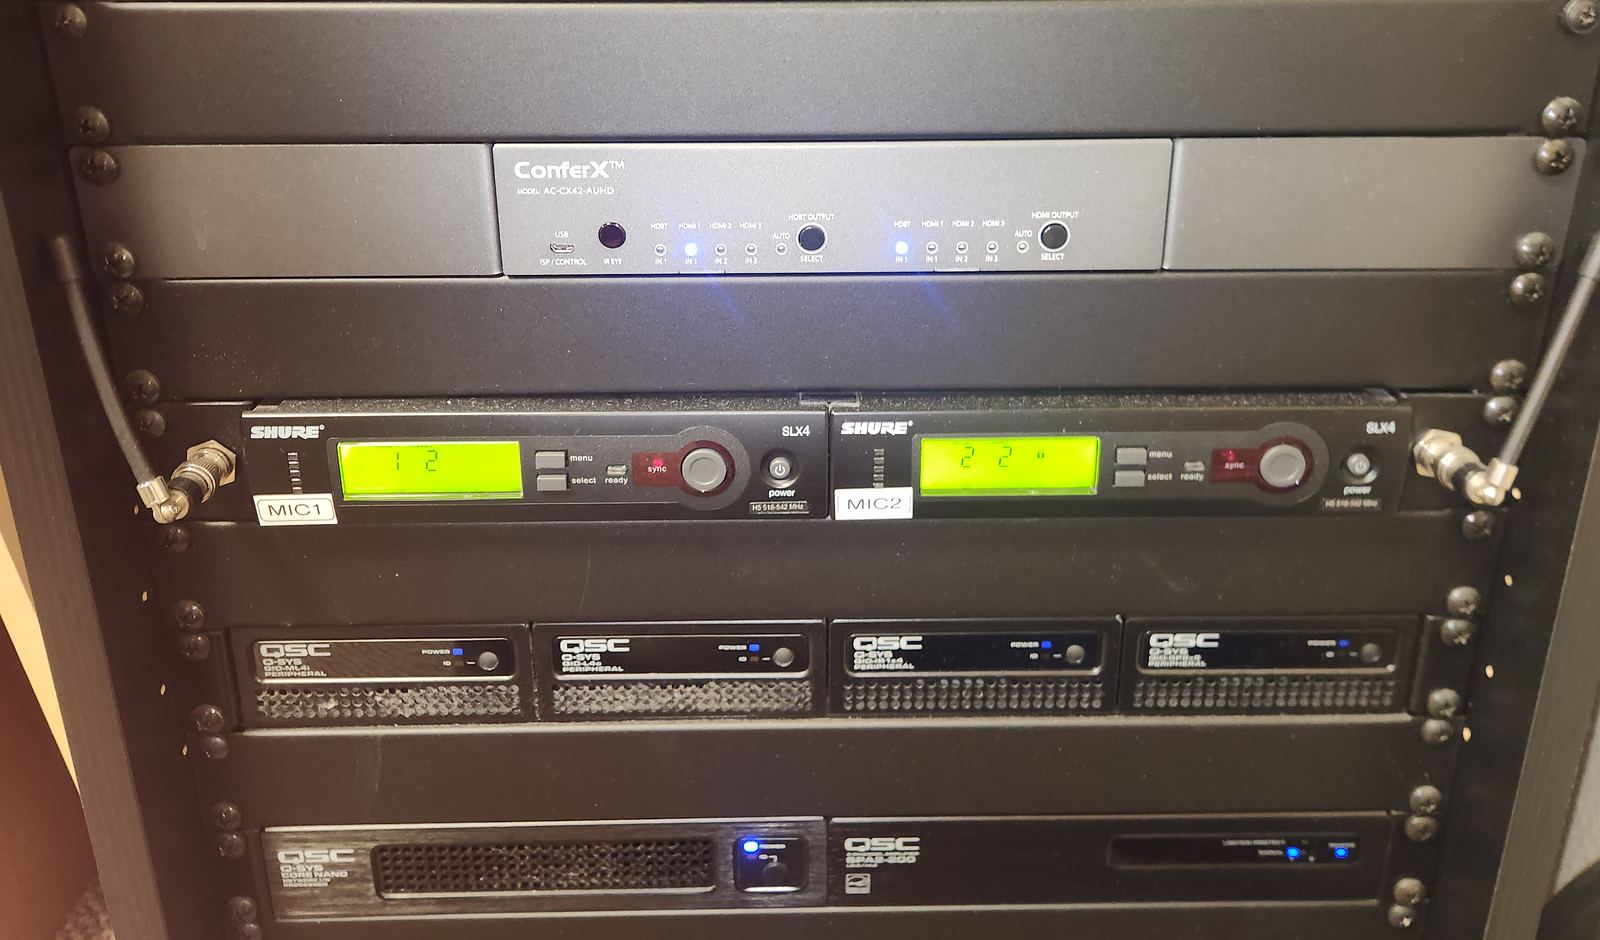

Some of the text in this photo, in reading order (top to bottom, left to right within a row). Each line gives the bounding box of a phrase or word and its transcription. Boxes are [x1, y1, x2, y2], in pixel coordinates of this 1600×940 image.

[543, 186, 615, 195] AC-CX42-AUHD
[808, 212, 835, 222] OUTPUT
[1031, 210, 1079, 219] HDMI OUTPUT
[554, 231, 569, 239] USB
[772, 232, 791, 240] AUTO
[1014, 230, 1033, 238] AUTO
[611, 257, 623, 265] EYE
[655, 257, 663, 265] IN
[685, 257, 693, 265] IN
[714, 257, 722, 265] IN
[744, 257, 752, 265] IN
[799, 254, 824, 263] SELECT
[925, 255, 933, 263] IN
[955, 254, 963, 263] IN
[985, 255, 993, 263] IN
[1040, 253, 1064, 261] SELECT
[555, 258, 588, 266] CONTROL
[781, 425, 811, 437] SLX4
[1365, 421, 1397, 435] SLX4
[570, 454, 593, 462] menu
[960, 445, 1013, 469] 2 2
[1149, 450, 1173, 459] menu
[425, 449, 438, 472] 2
[647, 465, 667, 473] sync
[1225, 461, 1244, 470] sync
[571, 476, 597, 485] select
[604, 476, 629, 486] ready
[1147, 472, 1173, 481] select
[1180, 472, 1204, 482] ready
[768, 489, 796, 499] power
[1343, 485, 1372, 496] power
[847, 497, 902, 510] MIC2
[267, 503, 323, 516] MIC1
[853, 635, 923, 651] QSC
[1149, 632, 1220, 649] QSC
[260, 643, 332, 658] QSC
[560, 638, 631, 654] QSC
[262, 658, 302, 666] Q-SYS
[264, 670, 327, 678] PERIPHERAL
[844, 836, 921, 853] QSC
[277, 848, 356, 864] QSC
